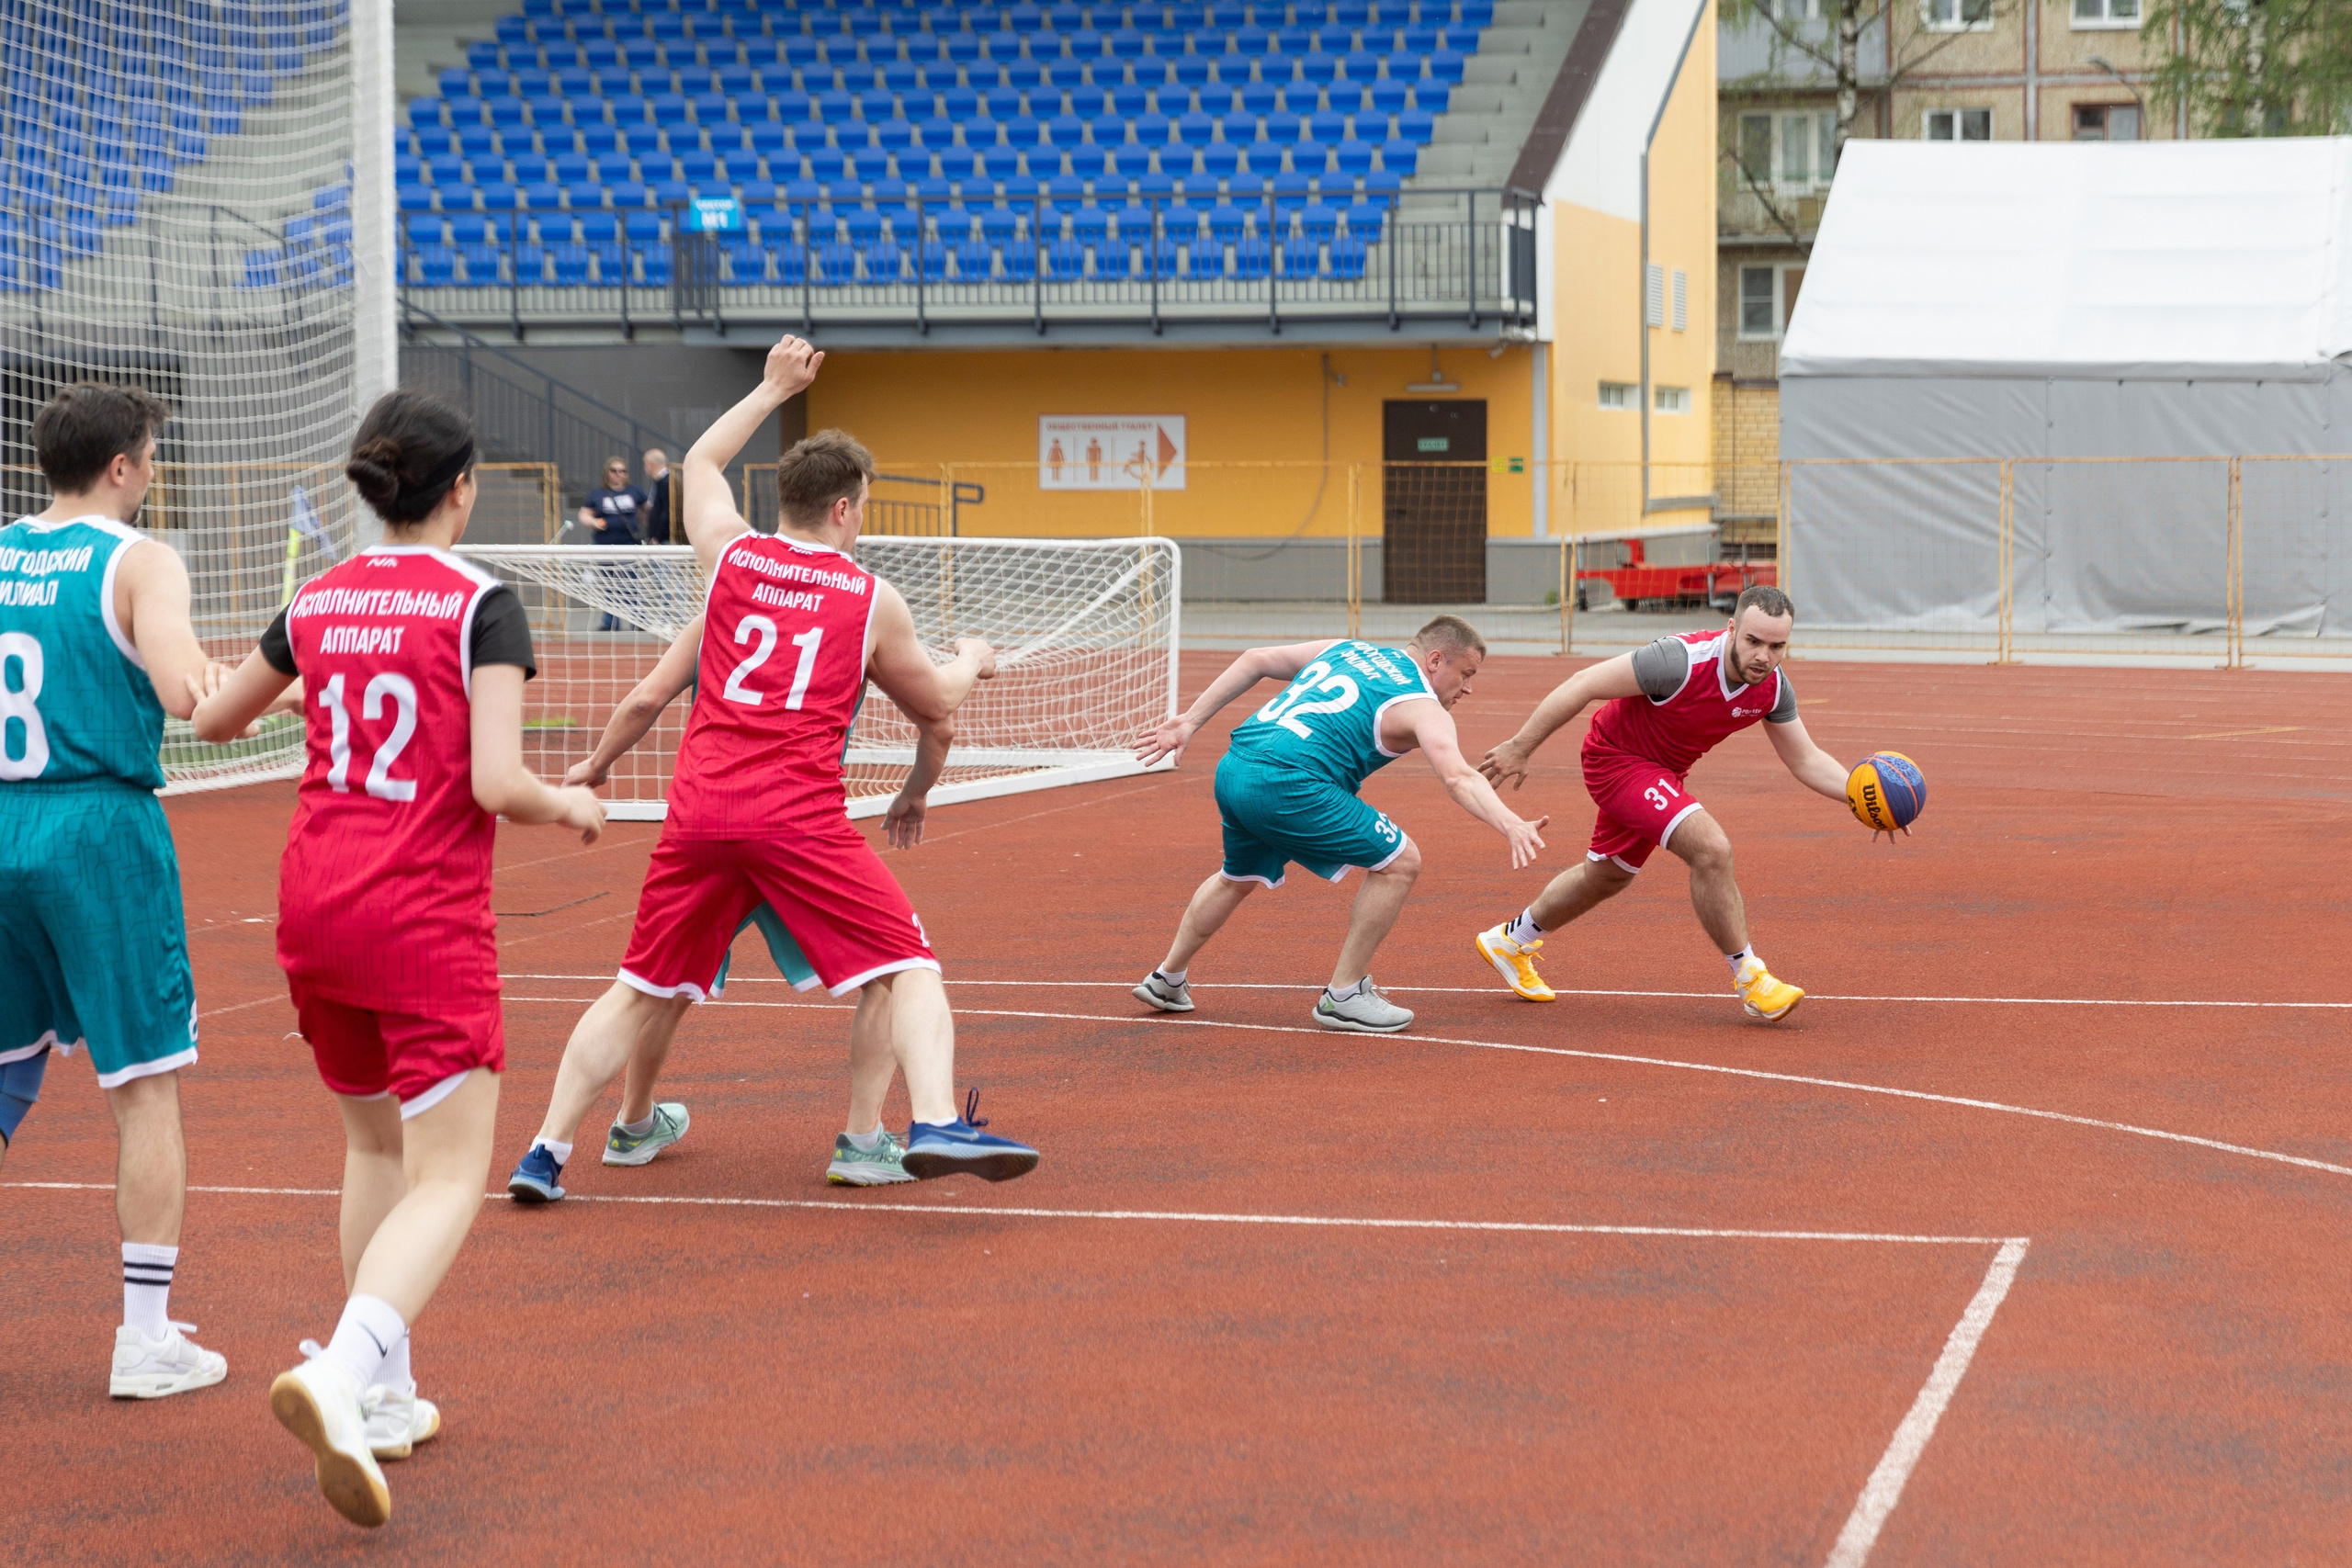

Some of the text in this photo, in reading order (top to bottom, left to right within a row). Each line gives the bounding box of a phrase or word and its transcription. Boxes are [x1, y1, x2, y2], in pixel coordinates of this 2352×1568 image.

[728, 547, 867, 596] ИСПОЛНИТЕЛЬНЫЙ
[292, 586, 465, 621] ИСПОЛНИТЕЛЬНЫЙ
[752, 582, 825, 613] АППАРАТ
[319, 626, 406, 655] АППАРАТ
[722, 614, 824, 711] 21
[0, 631, 50, 781] 8
[1257, 660, 1360, 739] 32
[319, 672, 417, 801] 12
[1644, 778, 1680, 811] 31
[1862, 783, 1887, 829] Wilson
[1374, 811, 1398, 843] 32
[878, 1153, 902, 1165] HOK
